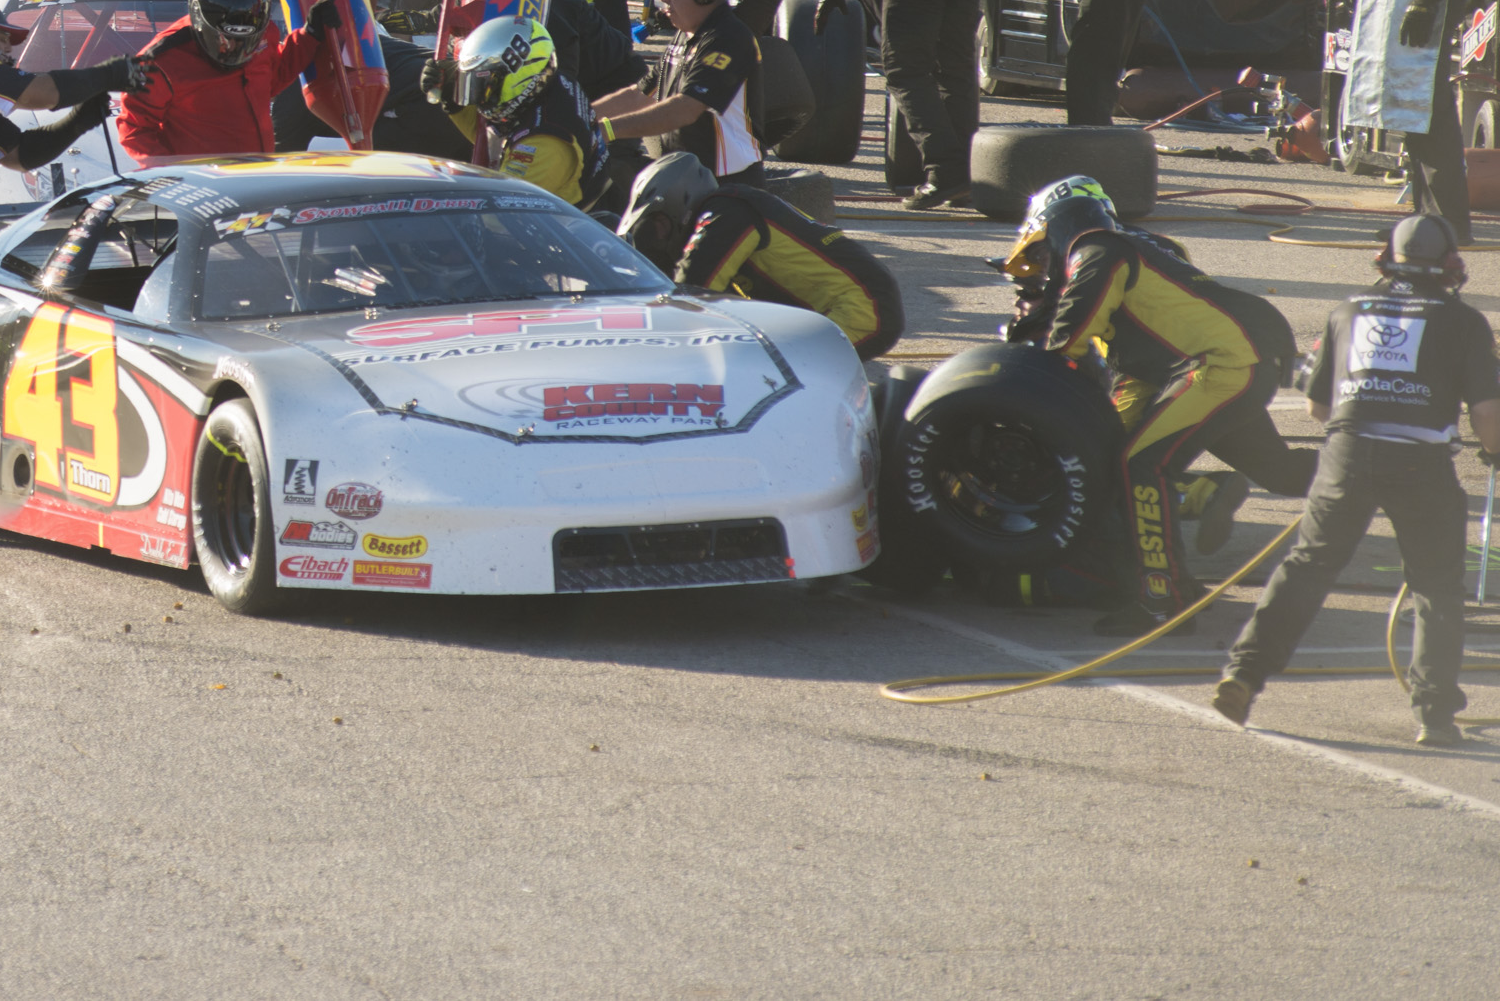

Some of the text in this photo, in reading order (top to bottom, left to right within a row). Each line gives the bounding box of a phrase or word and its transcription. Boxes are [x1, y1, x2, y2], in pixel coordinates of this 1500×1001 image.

[500, 33, 532, 74] 88
[702, 51, 732, 70] 43
[293, 200, 409, 224] SNOWBALL
[410, 198, 487, 213] DERBY
[347, 306, 652, 348] SPI
[342, 337, 519, 367] SURFACE
[1360, 350, 1409, 363] TOYOTA
[2, 301, 120, 507] 43
[543, 382, 725, 407] KERN
[542, 401, 726, 422] COUNTY
[556, 413, 718, 430] RACEWAY PAR
[70, 459, 111, 495] Thorn
[908, 423, 940, 513] Hoosier
[326, 486, 384, 509] OnTrack
[1054, 454, 1087, 549] Hoosier
[1134, 484, 1169, 570] ESTES
[368, 537, 422, 556] Bassett
[279, 555, 349, 580] Eibach
[355, 563, 420, 577] BUTLERBUILT
